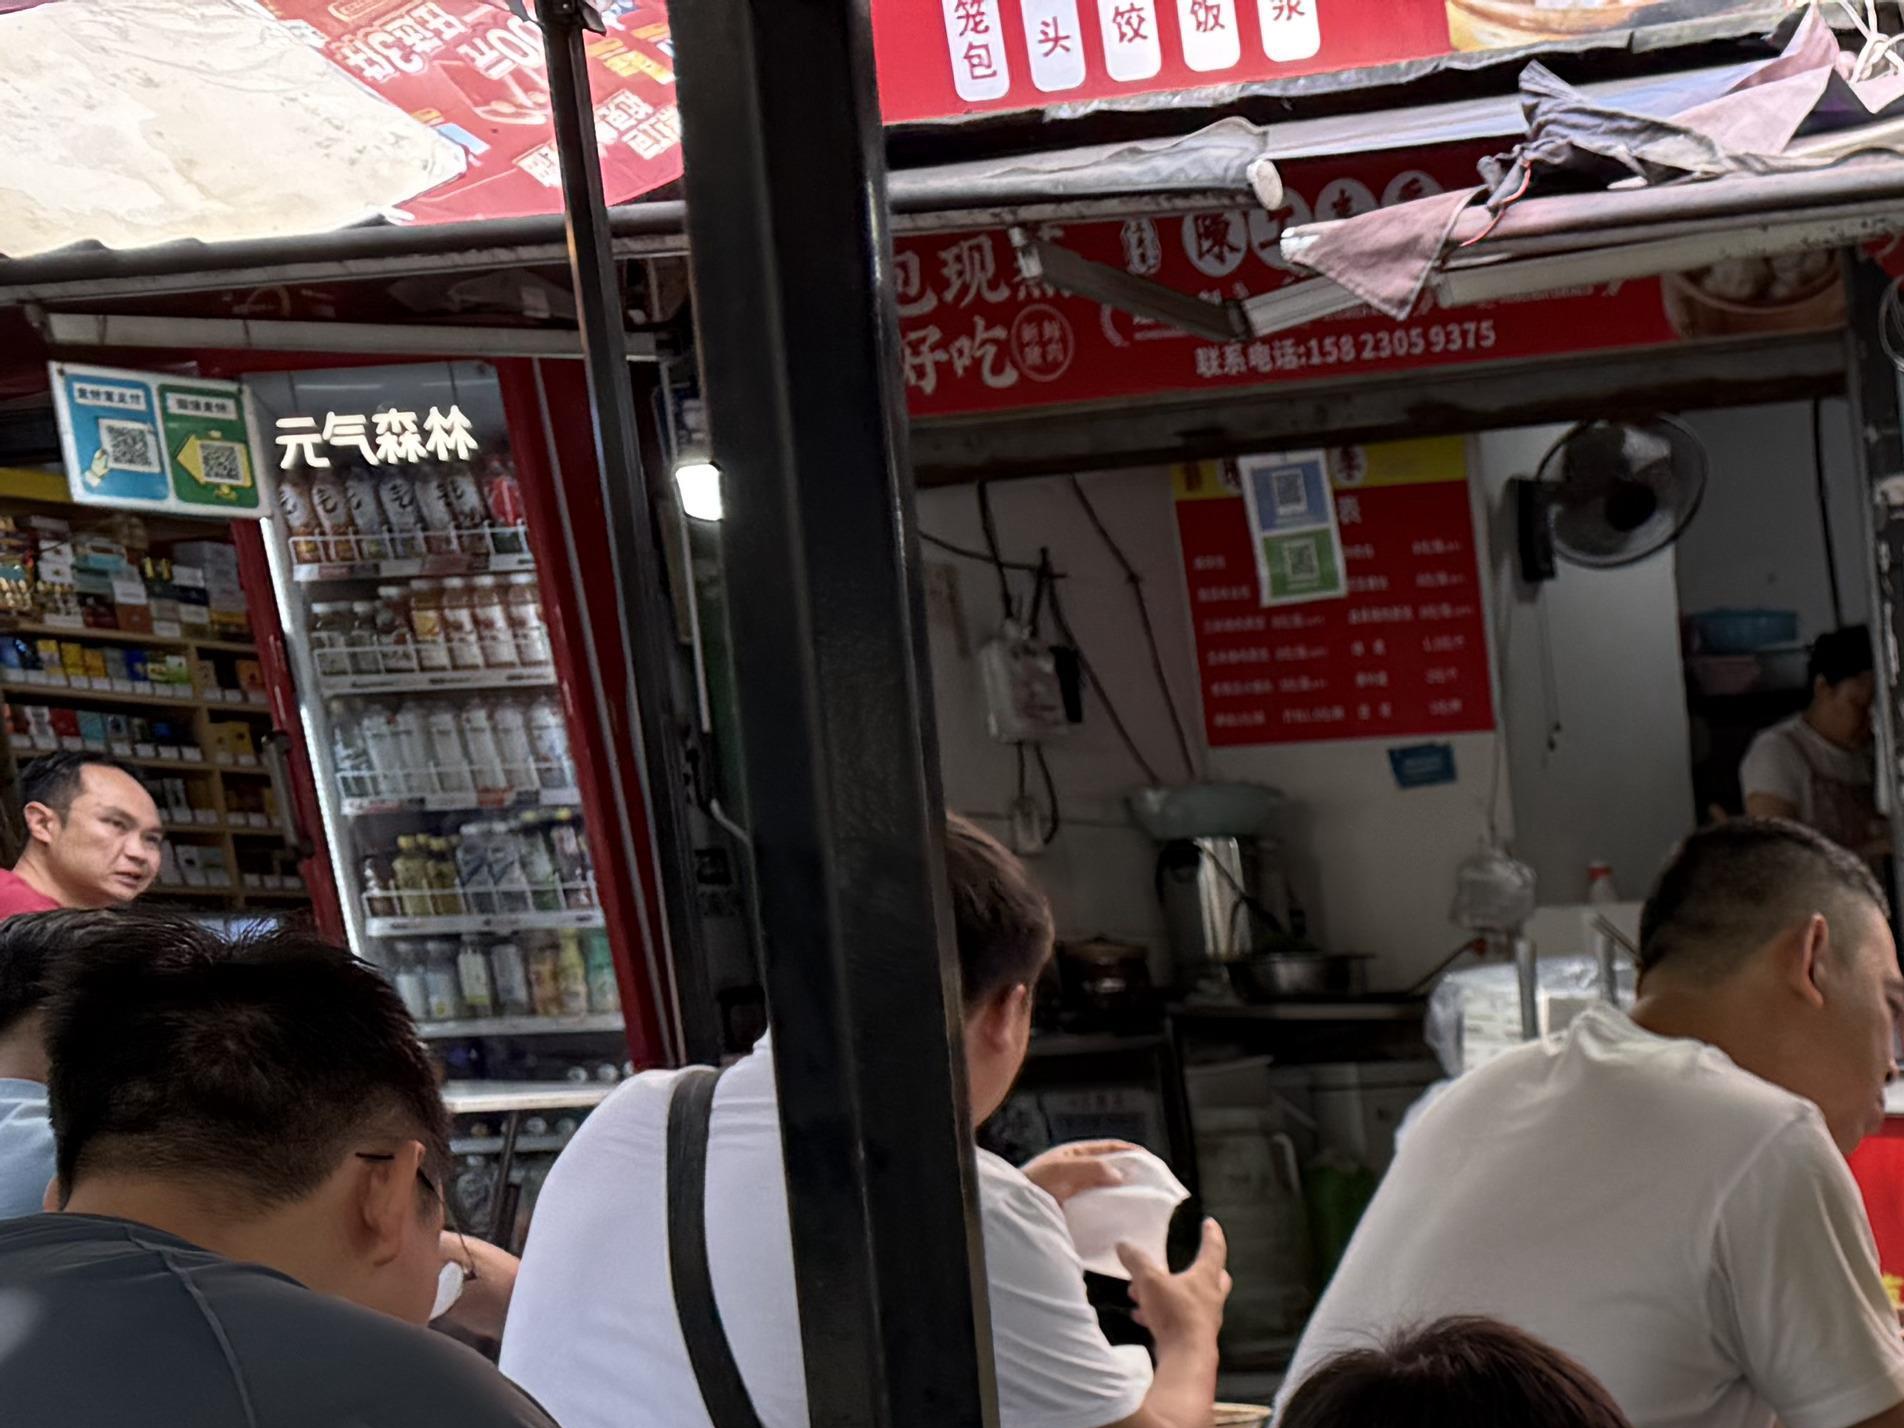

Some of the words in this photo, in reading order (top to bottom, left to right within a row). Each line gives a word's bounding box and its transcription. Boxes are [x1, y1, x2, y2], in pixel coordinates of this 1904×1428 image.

[1111, 3, 1149, 44] 饺
[1431, 318, 1496, 352] 9375
[275, 404, 480, 470] 元气森林
